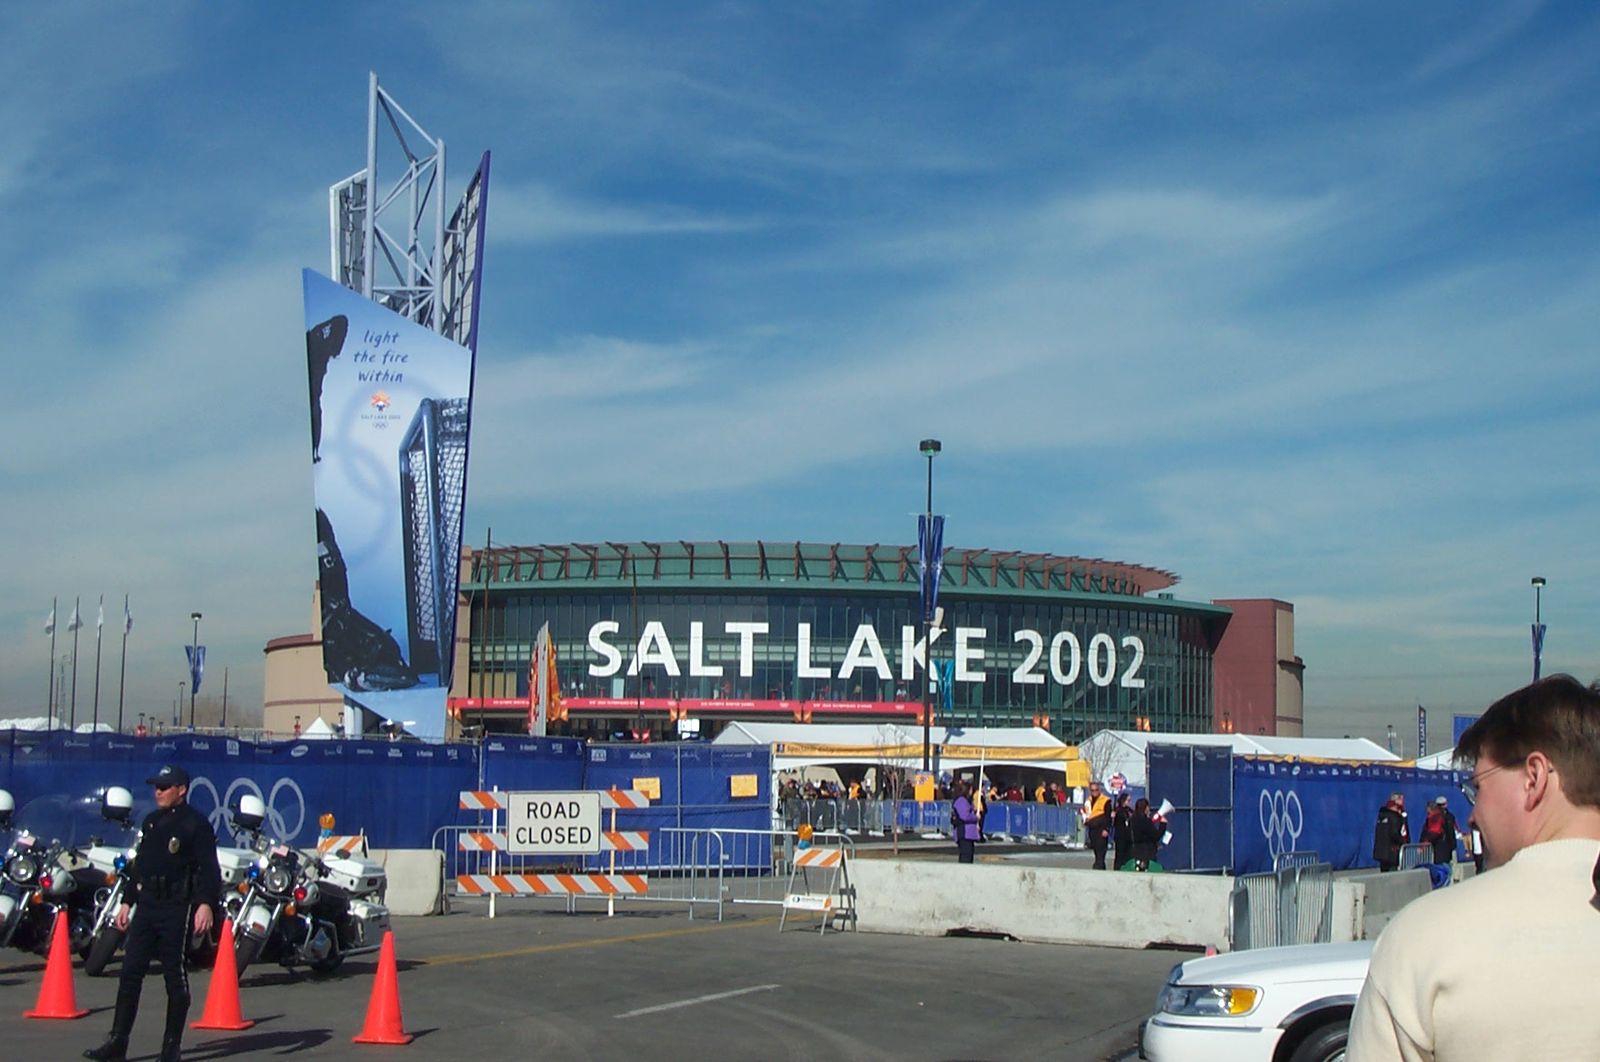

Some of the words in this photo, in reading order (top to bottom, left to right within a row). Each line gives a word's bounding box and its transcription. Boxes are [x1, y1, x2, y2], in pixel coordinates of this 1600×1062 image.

[363, 330, 400, 348] light
[353, 349, 376, 363] the
[382, 348, 409, 365] fire
[358, 369, 404, 383] within
[588, 620, 769, 677] SALT
[797, 622, 987, 682] LAKE
[1012, 629, 1146, 689] 2002
[526, 801, 581, 819] ROAD
[516, 826, 592, 845] CLOSED
